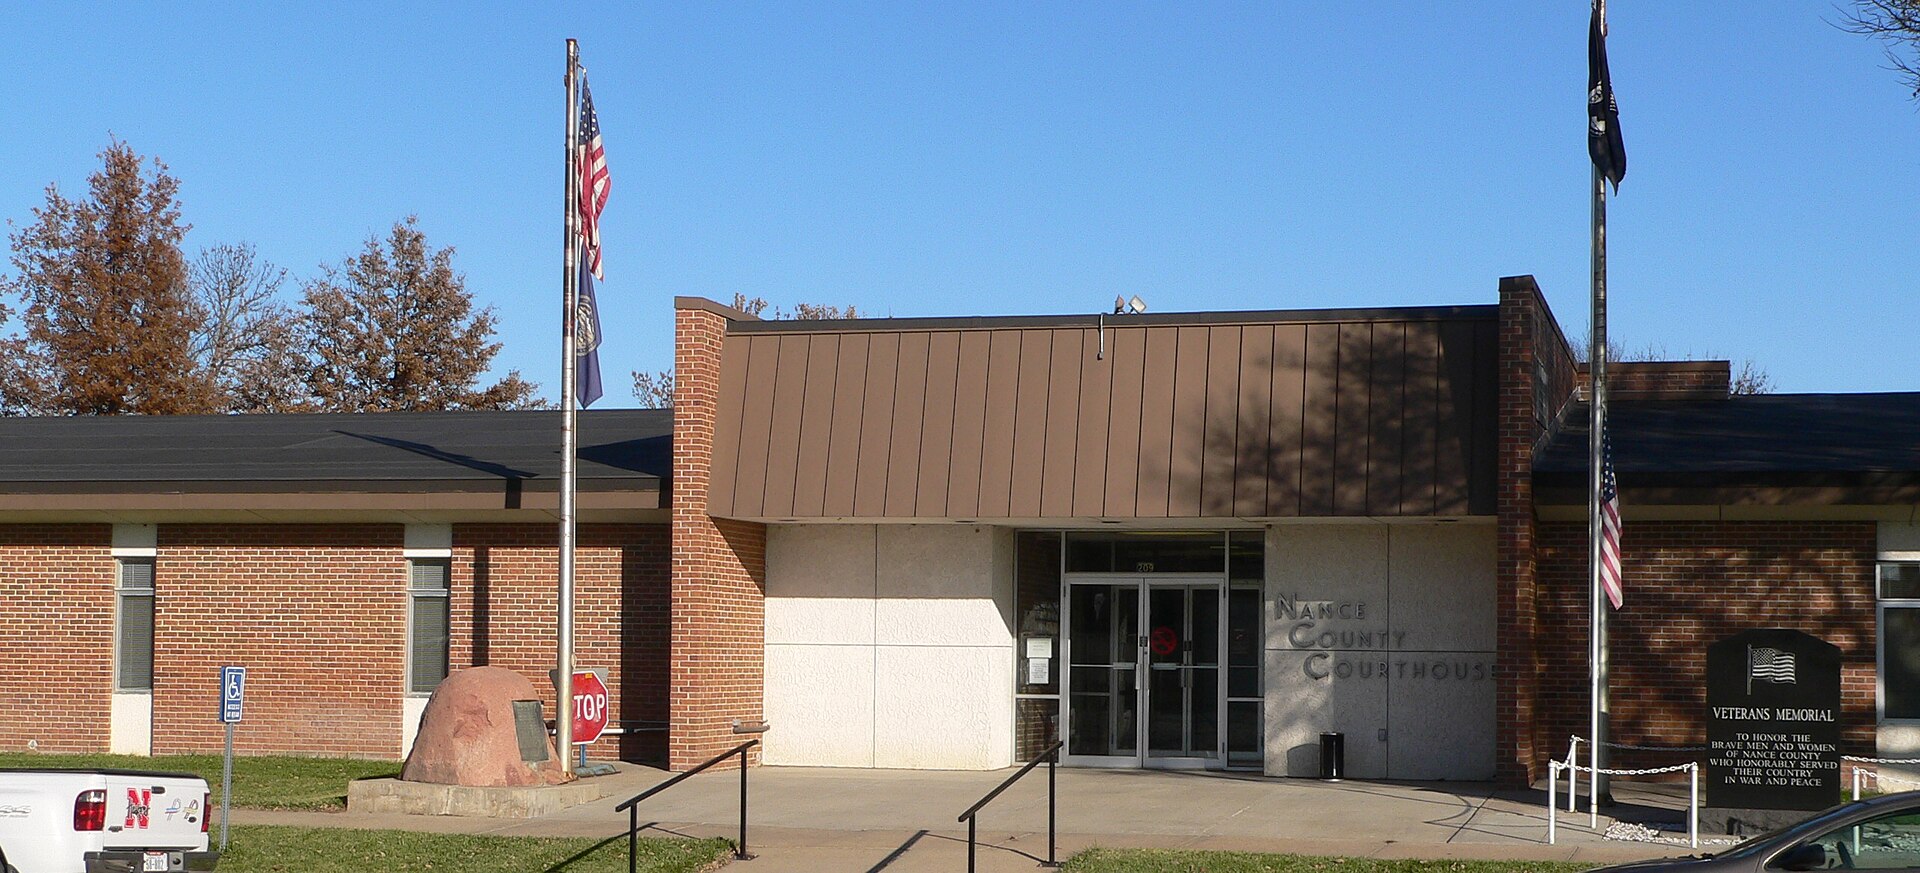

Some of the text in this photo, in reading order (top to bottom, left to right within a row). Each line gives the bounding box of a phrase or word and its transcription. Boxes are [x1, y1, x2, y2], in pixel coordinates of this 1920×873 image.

[573, 693, 605, 722] TOP
[1713, 707, 1834, 722] VETERANS MEMORIAL
[1736, 733, 1811, 742] TO HONOR THE
[1798, 743, 1835, 751] WOMEN
[1726, 750, 1821, 760] OF NANCE COUNTY
[1710, 759, 1838, 769] WHO HONORABLY SERVED
[1733, 768, 1813, 777] THEIR COUNTRY
[1791, 778, 1822, 786] PEACE
